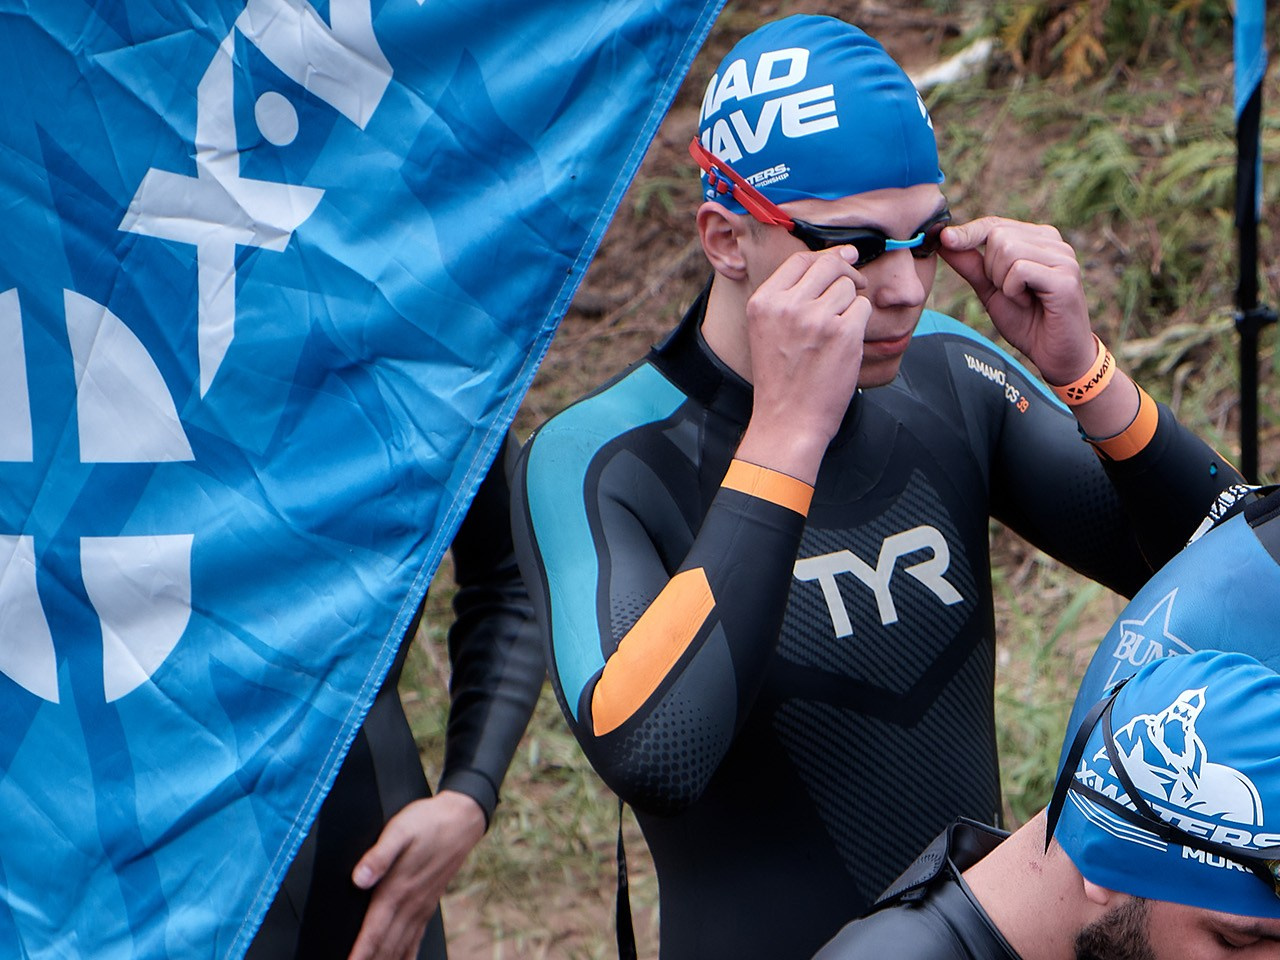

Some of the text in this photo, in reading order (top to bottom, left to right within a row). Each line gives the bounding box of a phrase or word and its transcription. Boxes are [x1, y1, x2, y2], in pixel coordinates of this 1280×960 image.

[701, 84, 840, 165] AVE
[793, 524, 964, 639] TYR
[1113, 630, 1178, 667] BUN
